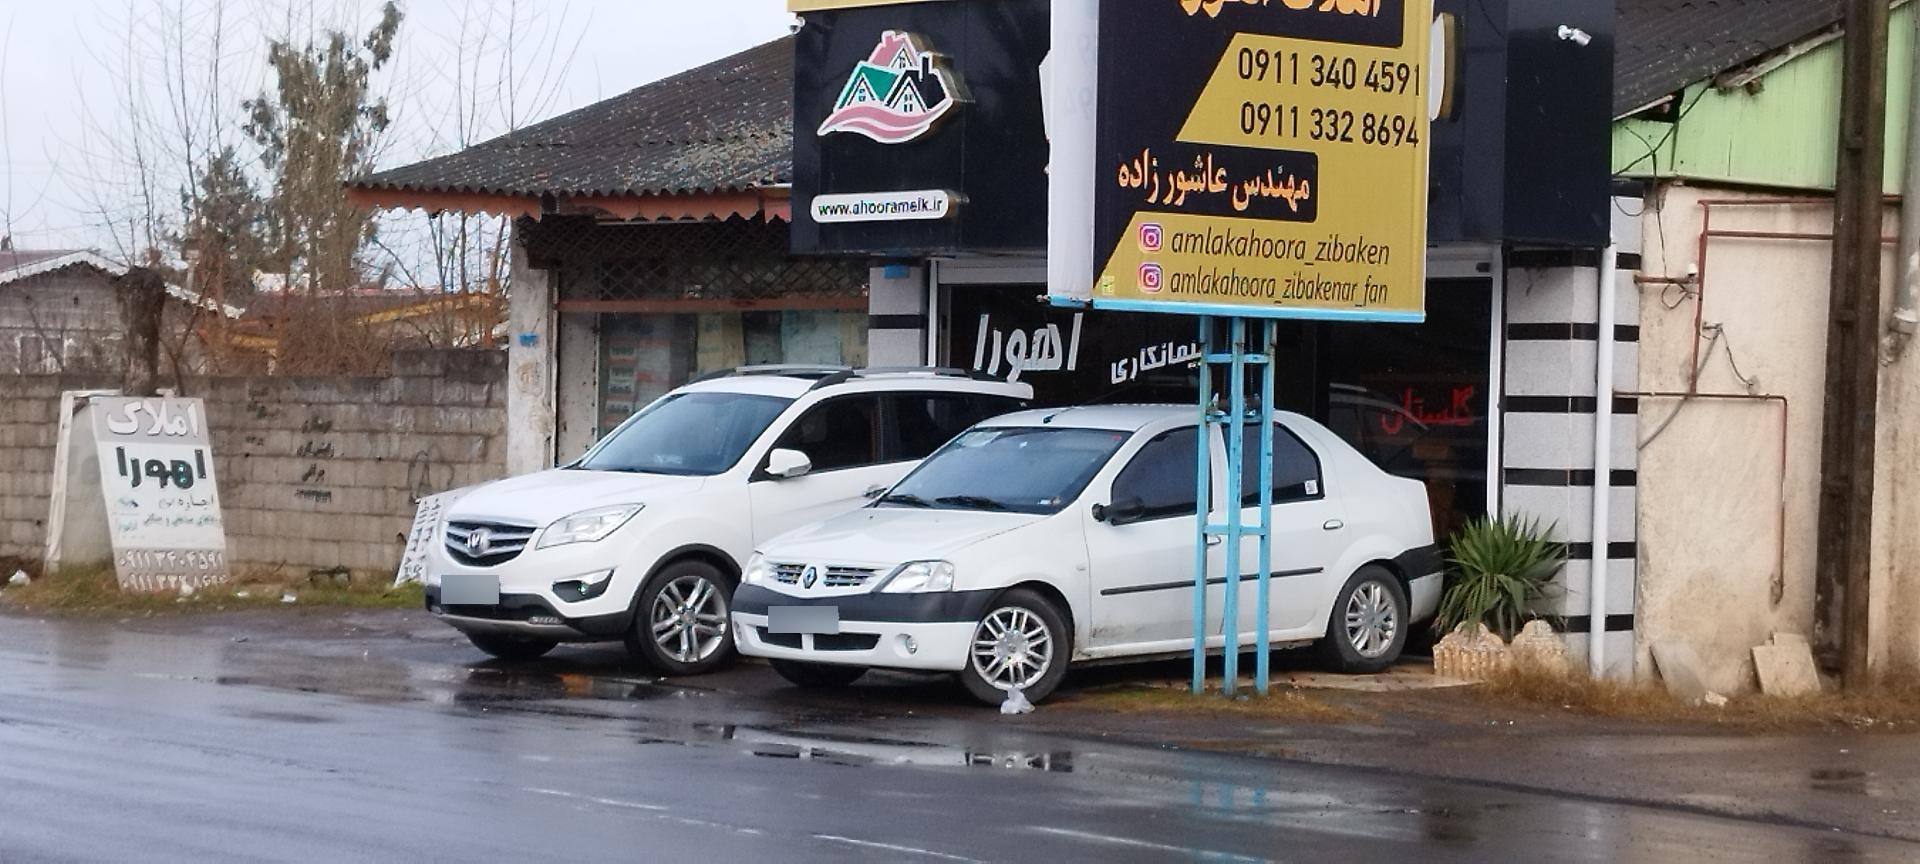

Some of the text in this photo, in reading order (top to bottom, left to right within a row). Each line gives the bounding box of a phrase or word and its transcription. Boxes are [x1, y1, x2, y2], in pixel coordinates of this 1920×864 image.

[1238, 47, 1420, 97] 0911 340 4591
[1240, 100, 1419, 148] 0911 332 8694
[817, 196, 943, 217] www.ahooramelk.ir
[1232, 164, 1311, 214] مهندس
[1170, 226, 1390, 266] amlakahoora_zibaken
[1170, 267, 1389, 308] amlakahoora_zibakenar_fan
[973, 312, 1084, 383] اهورا
[107, 398, 200, 438] املاک
[115, 445, 207, 490] اهورا
[177, 494, 215, 511] اجاره
